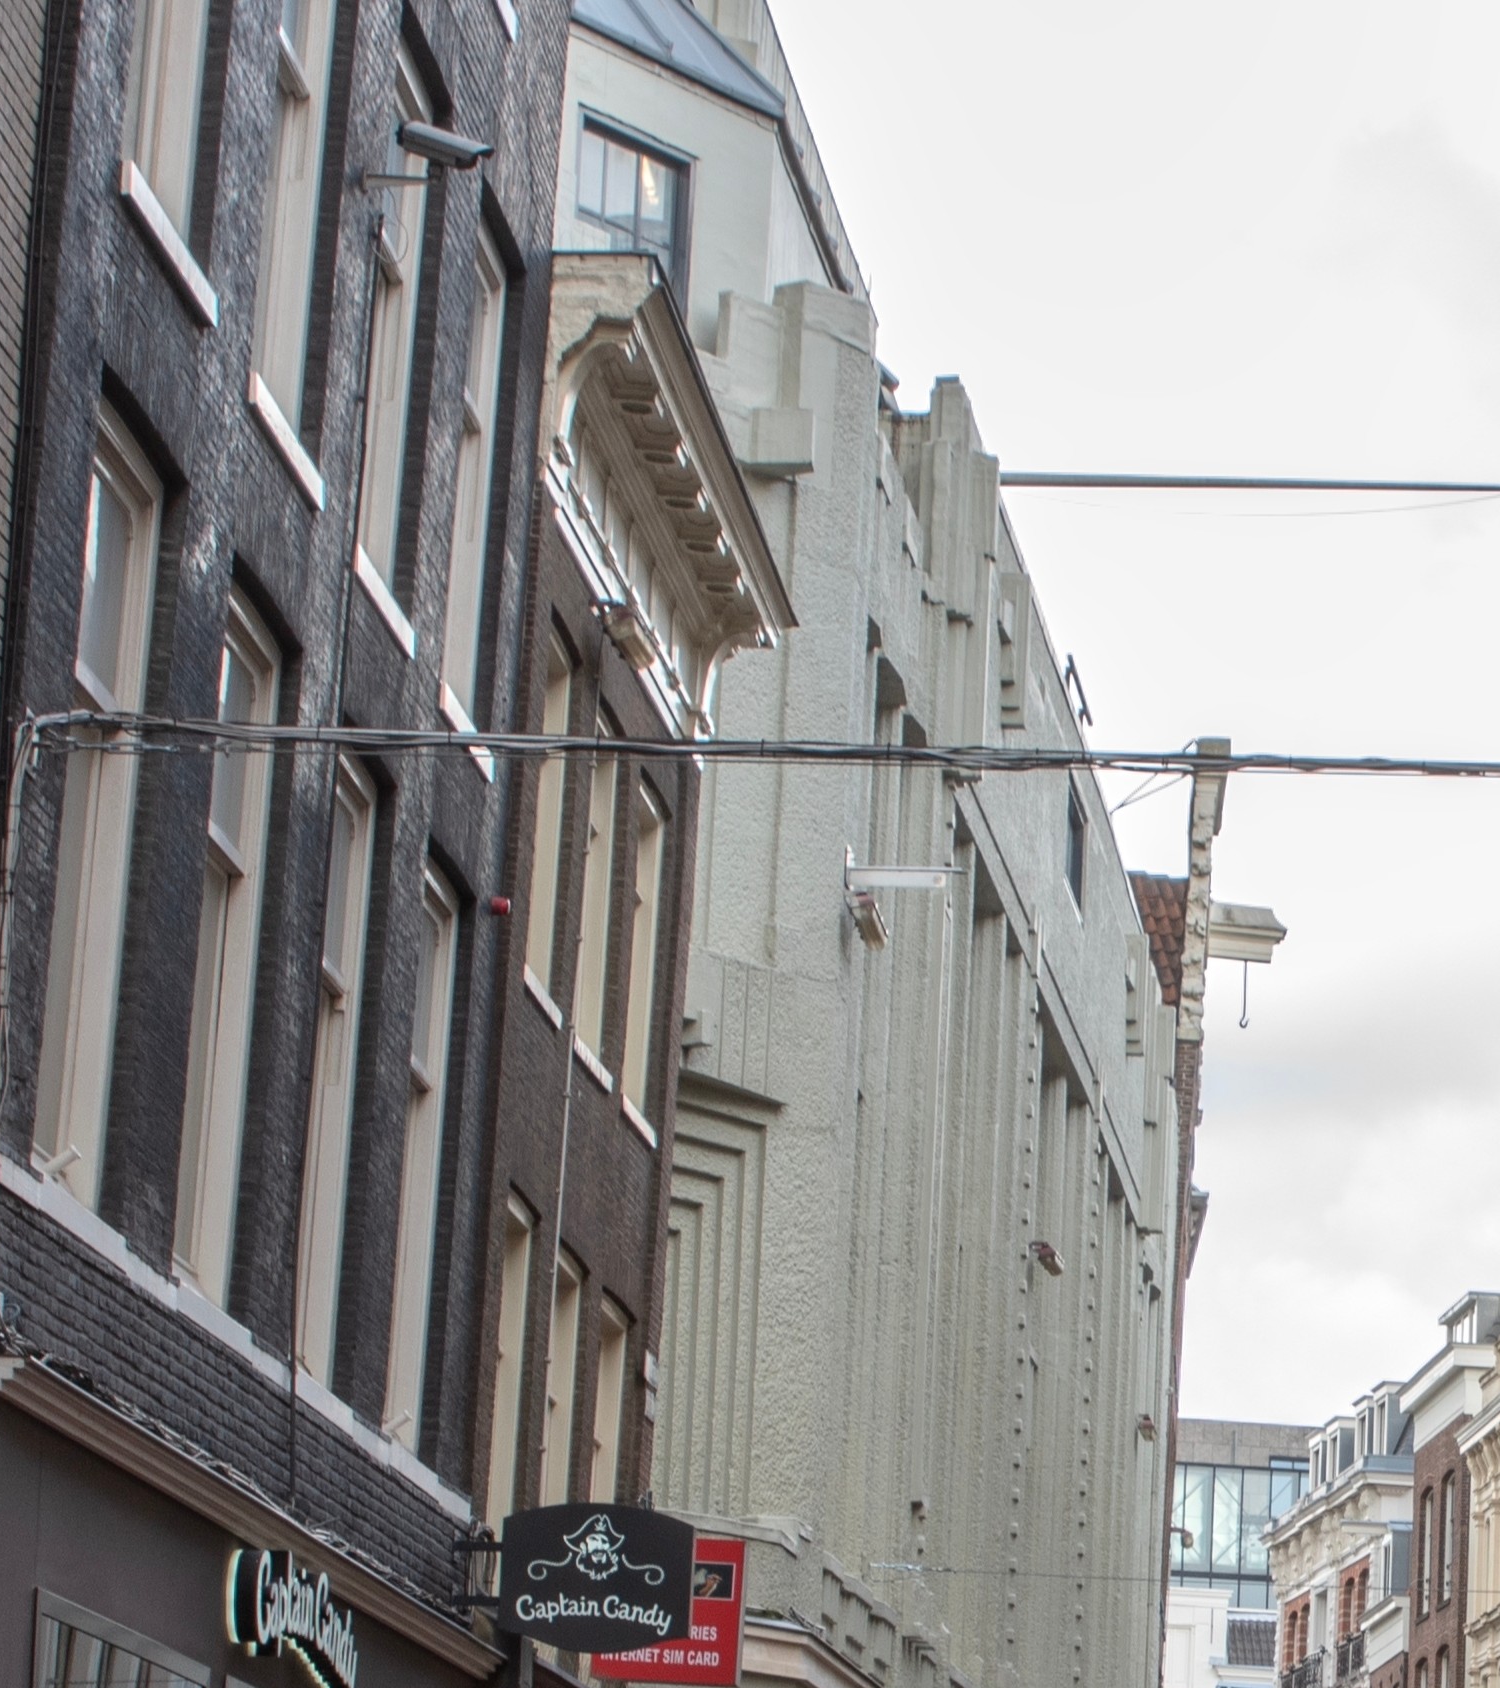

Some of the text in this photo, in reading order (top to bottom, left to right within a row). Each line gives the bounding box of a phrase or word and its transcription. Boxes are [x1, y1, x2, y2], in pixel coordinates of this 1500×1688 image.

[257, 1549, 315, 1658] Captain
[515, 1592, 672, 1636] Captain Candy
[689, 1625, 718, 1641] RIES
[662, 1650, 684, 1665] SIM
[687, 1651, 720, 1667] CARD
